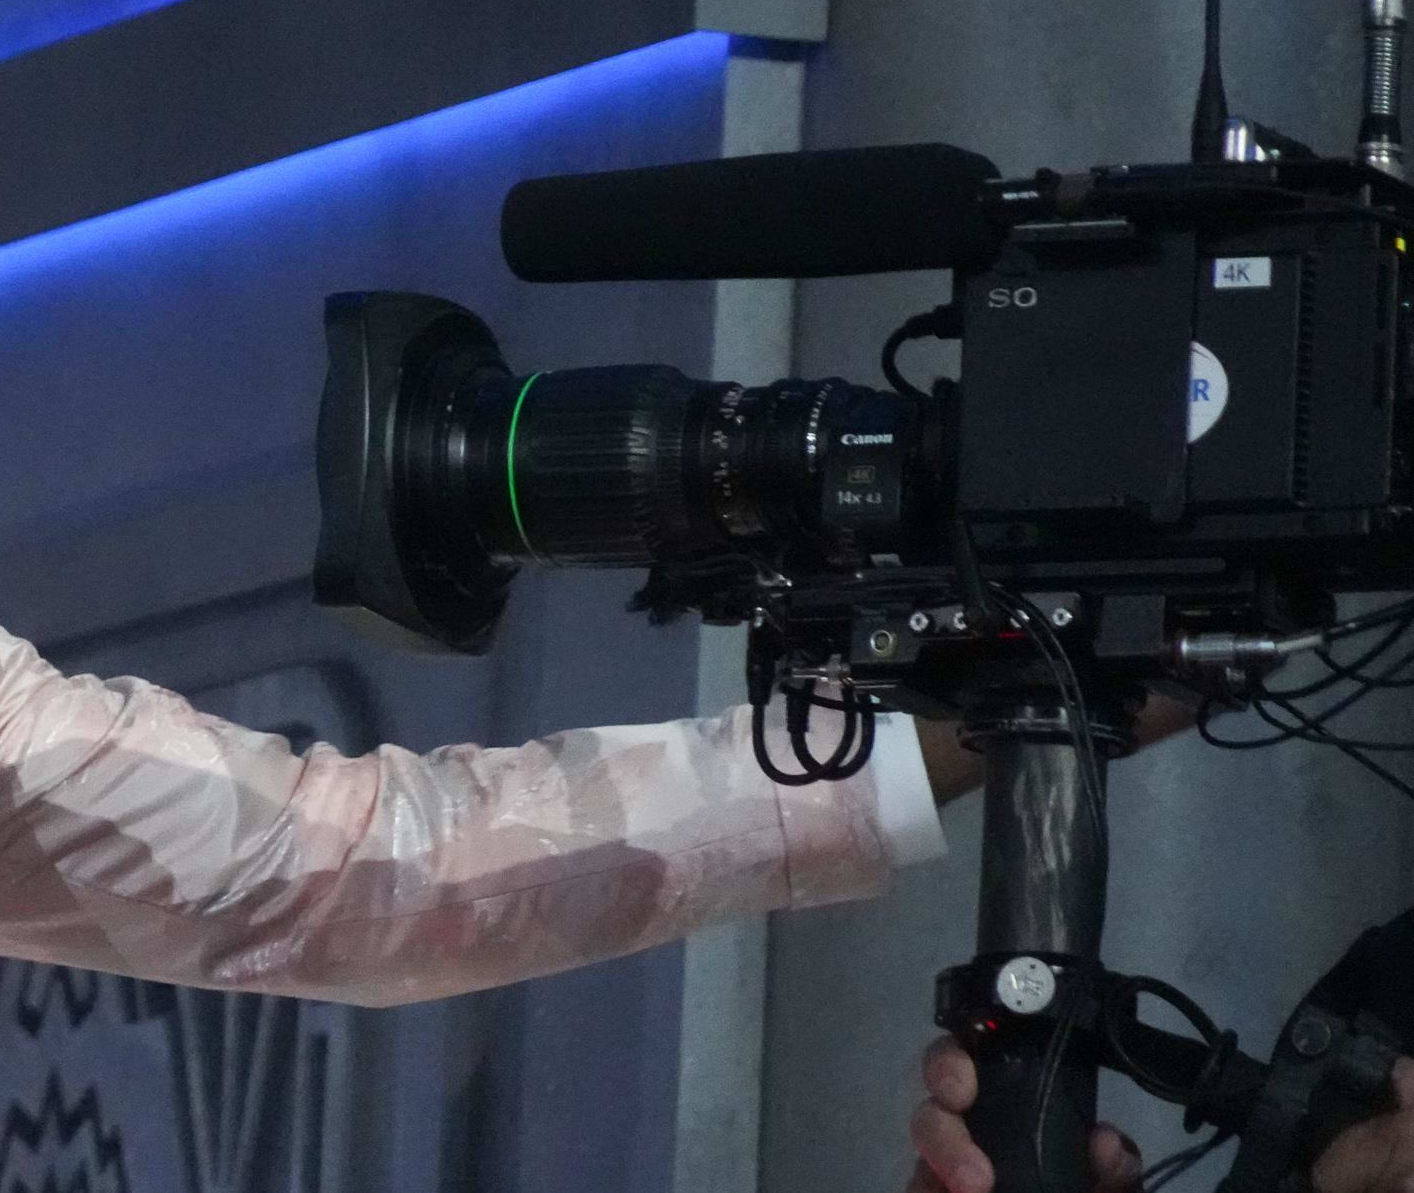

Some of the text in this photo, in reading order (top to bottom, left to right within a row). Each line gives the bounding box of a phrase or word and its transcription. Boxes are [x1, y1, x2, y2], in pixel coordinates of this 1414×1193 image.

[1223, 264, 1251, 283] 4K
[988, 286, 1038, 308] SO
[840, 433, 894, 445] Canon
